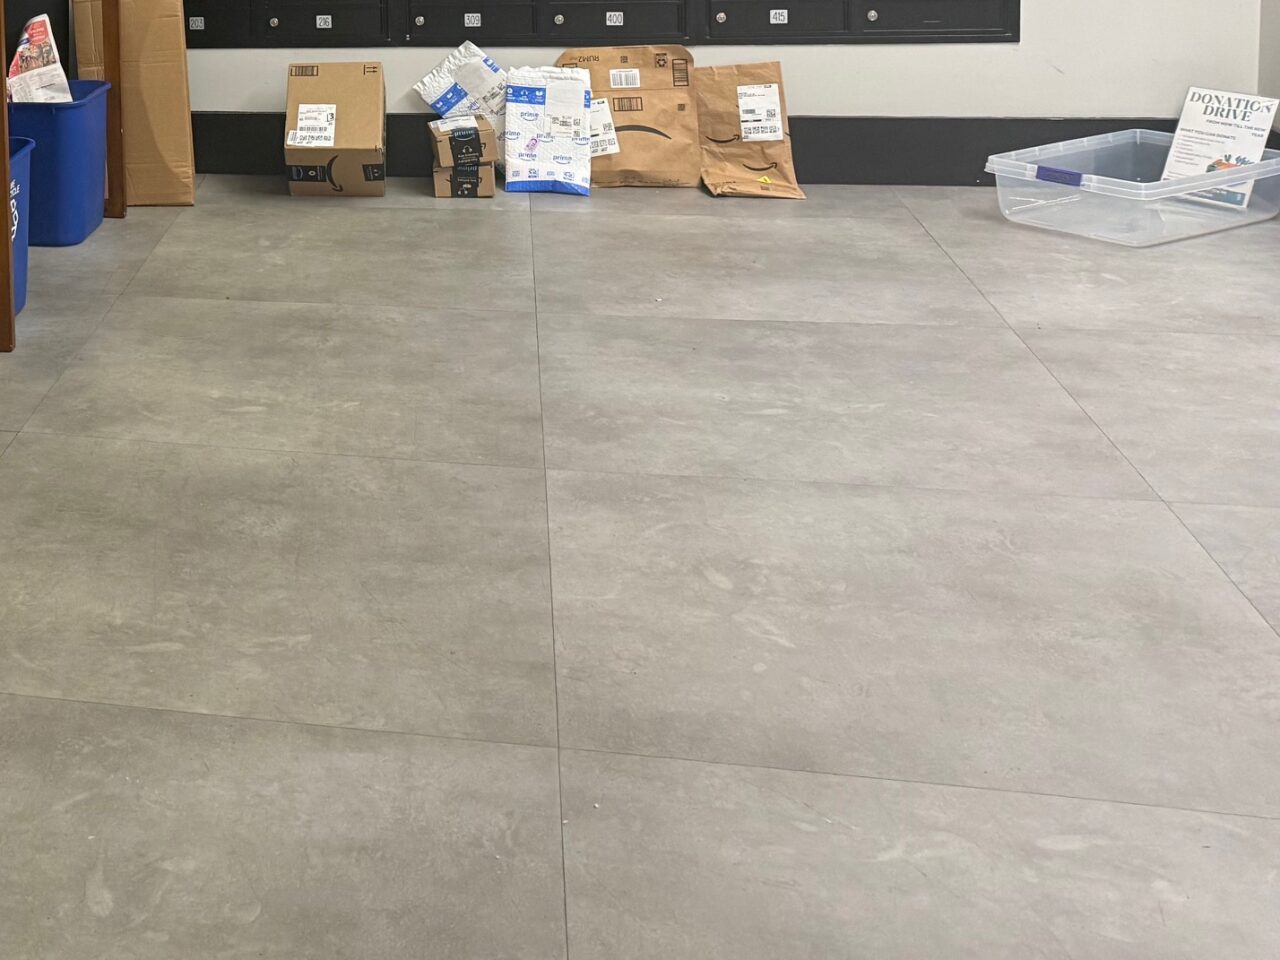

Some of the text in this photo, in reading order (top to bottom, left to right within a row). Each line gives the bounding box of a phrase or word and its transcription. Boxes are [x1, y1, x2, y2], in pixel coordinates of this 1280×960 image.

[465, 14, 481, 26] 309
[606, 12, 623, 25] 400
[771, 10, 787, 23] 415
[190, 17, 204, 30] 203
[1189, 91, 1274, 113] DONATION
[520, 110, 540, 118] prime
[1203, 104, 1253, 122] DRIVE
